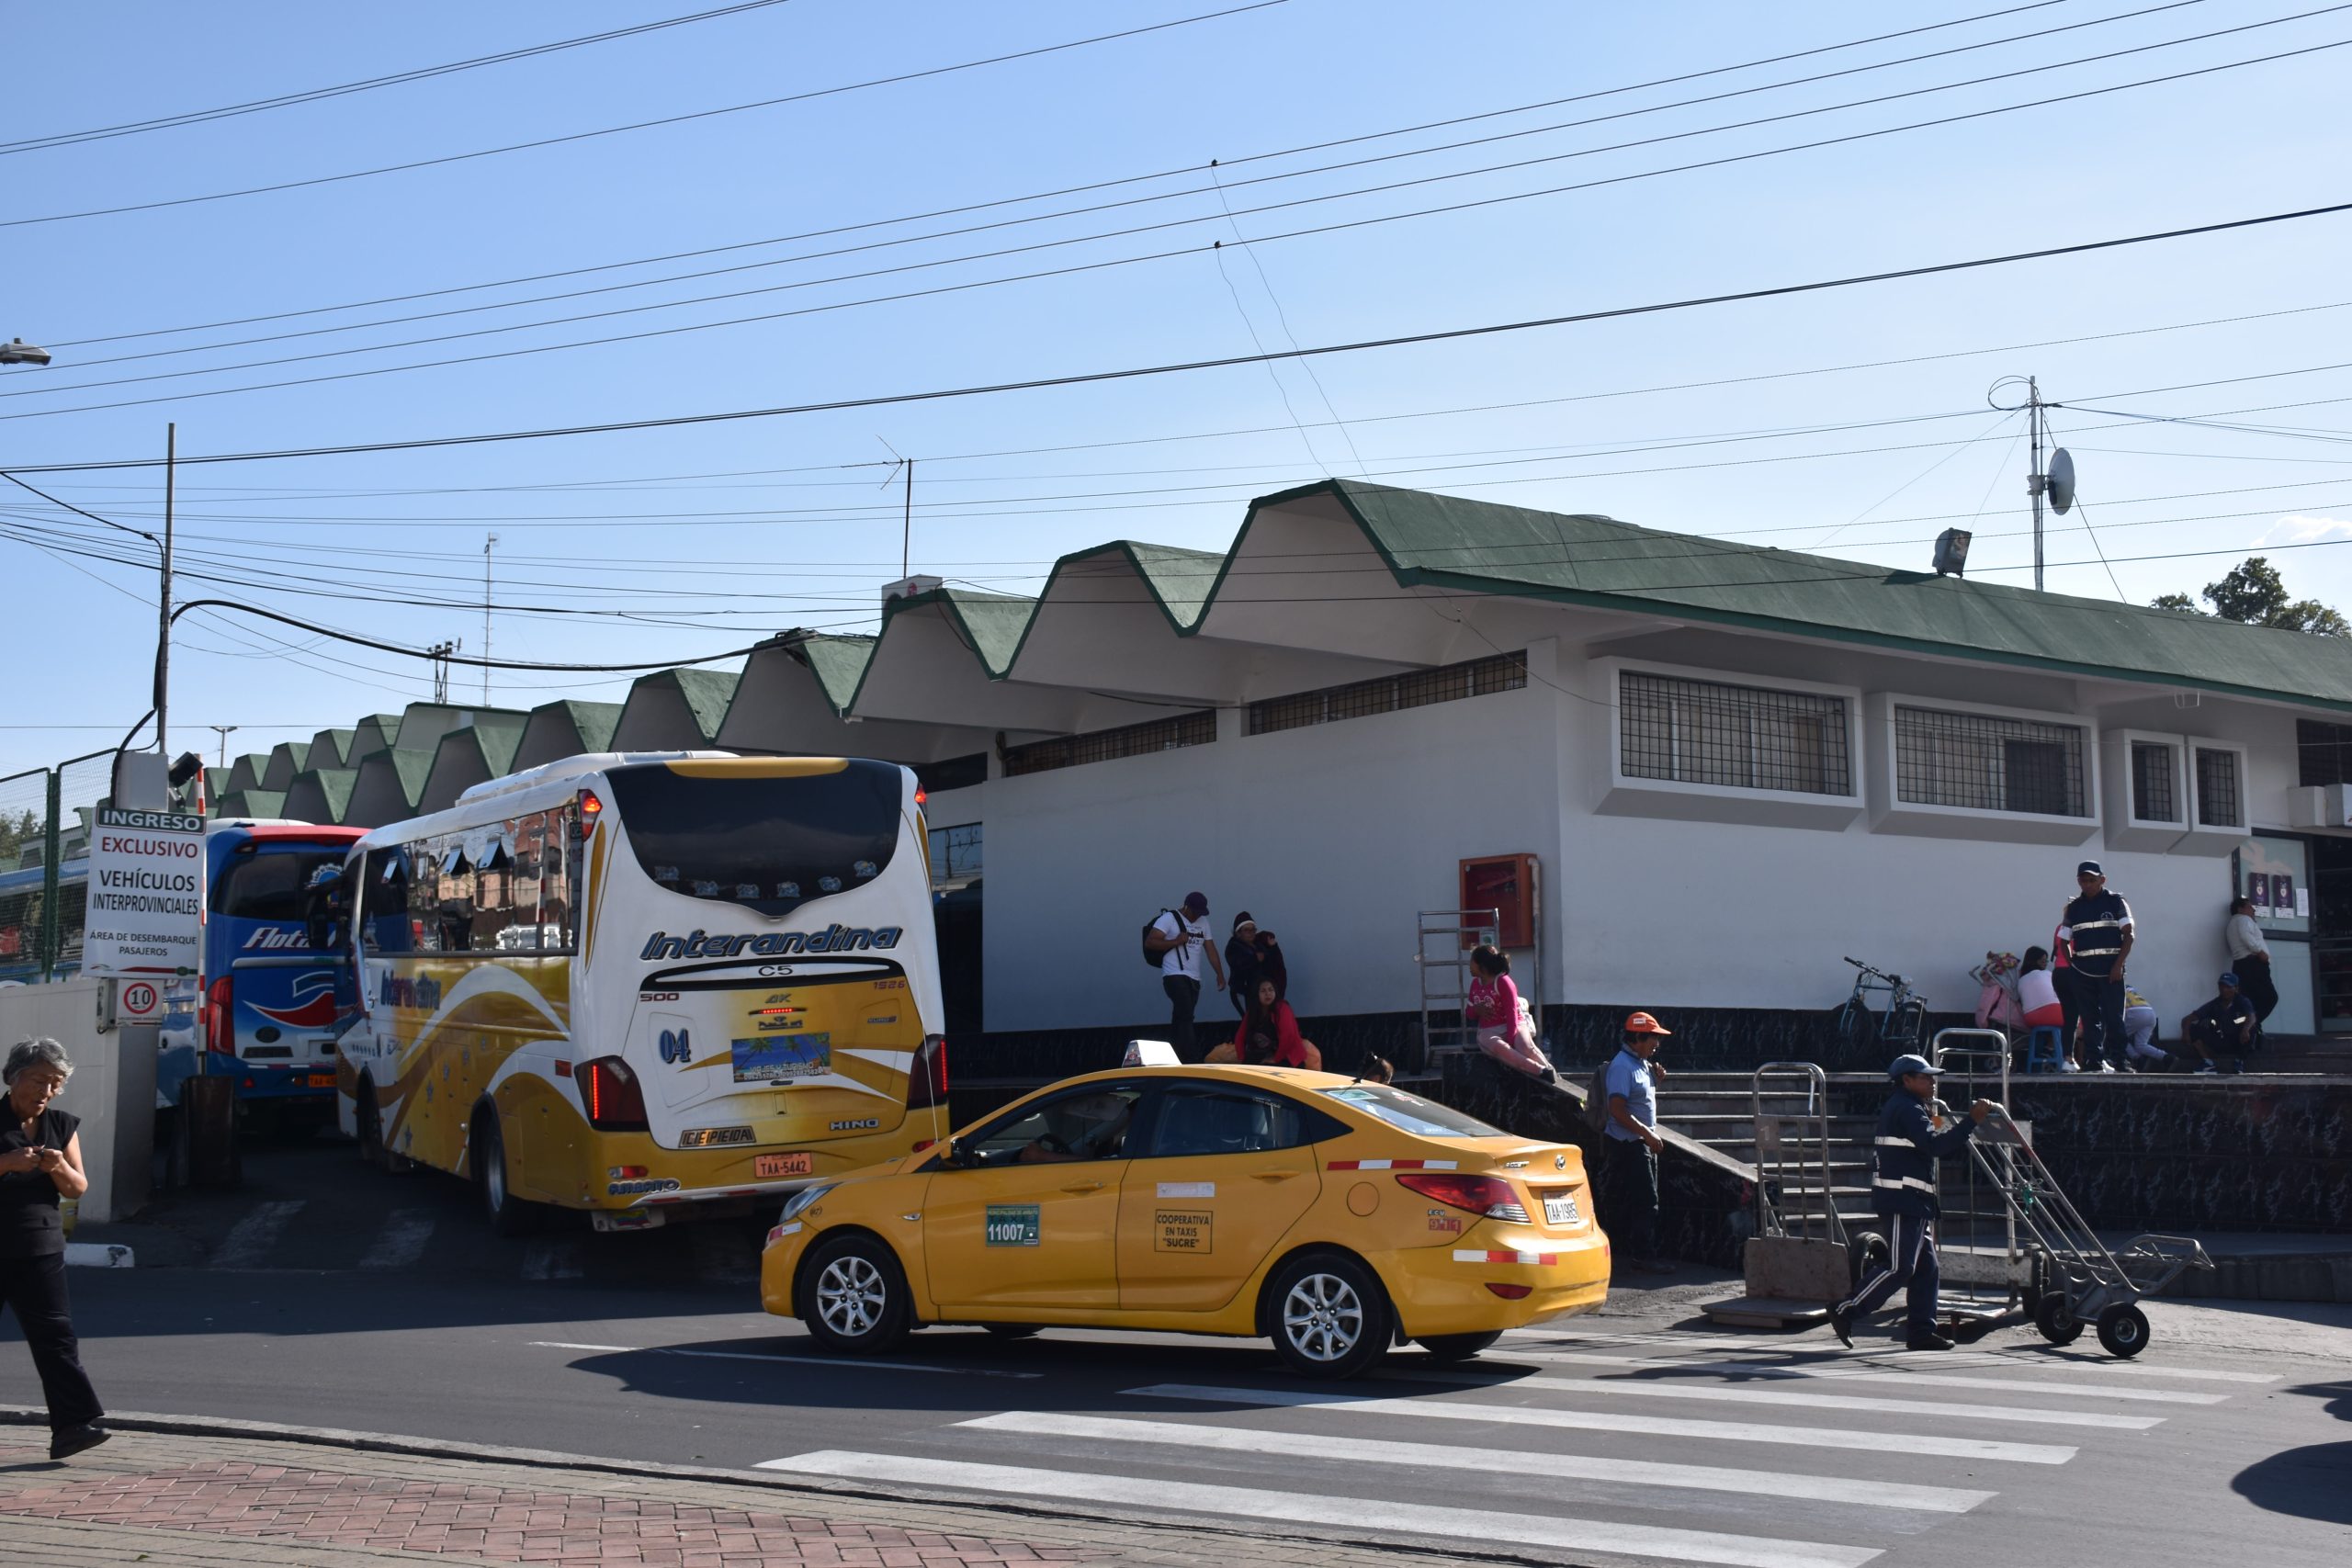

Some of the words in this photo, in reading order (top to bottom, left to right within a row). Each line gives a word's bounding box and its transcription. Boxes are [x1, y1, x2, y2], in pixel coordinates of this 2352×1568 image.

[103, 809, 200, 831] INGRESO
[101, 836, 198, 859] EXCLUSIVO
[99, 868, 196, 892] VEHÍCULOS
[93, 893, 198, 916] INTERPROVINCIALES
[90, 930, 114, 941] ÁREA
[117, 932, 129, 942] DE
[130, 933, 197, 945] DESEMBARQUE
[639, 923, 904, 961] Interandina
[119, 946, 168, 956] PASAJEROS
[758, 965, 793, 977] C5
[131, 989, 151, 1005] 10
[639, 992, 680, 1002] 500
[659, 1028, 691, 1064] 04
[830, 1119, 879, 1132] HINO
[760, 1160, 807, 1176] TAA-5442
[1157, 1214, 1210, 1224] COOPERATIVA
[988, 1224, 1024, 1241] 11007
[1165, 1226, 1175, 1235] EN
[1177, 1227, 1198, 1236] TAXIS
